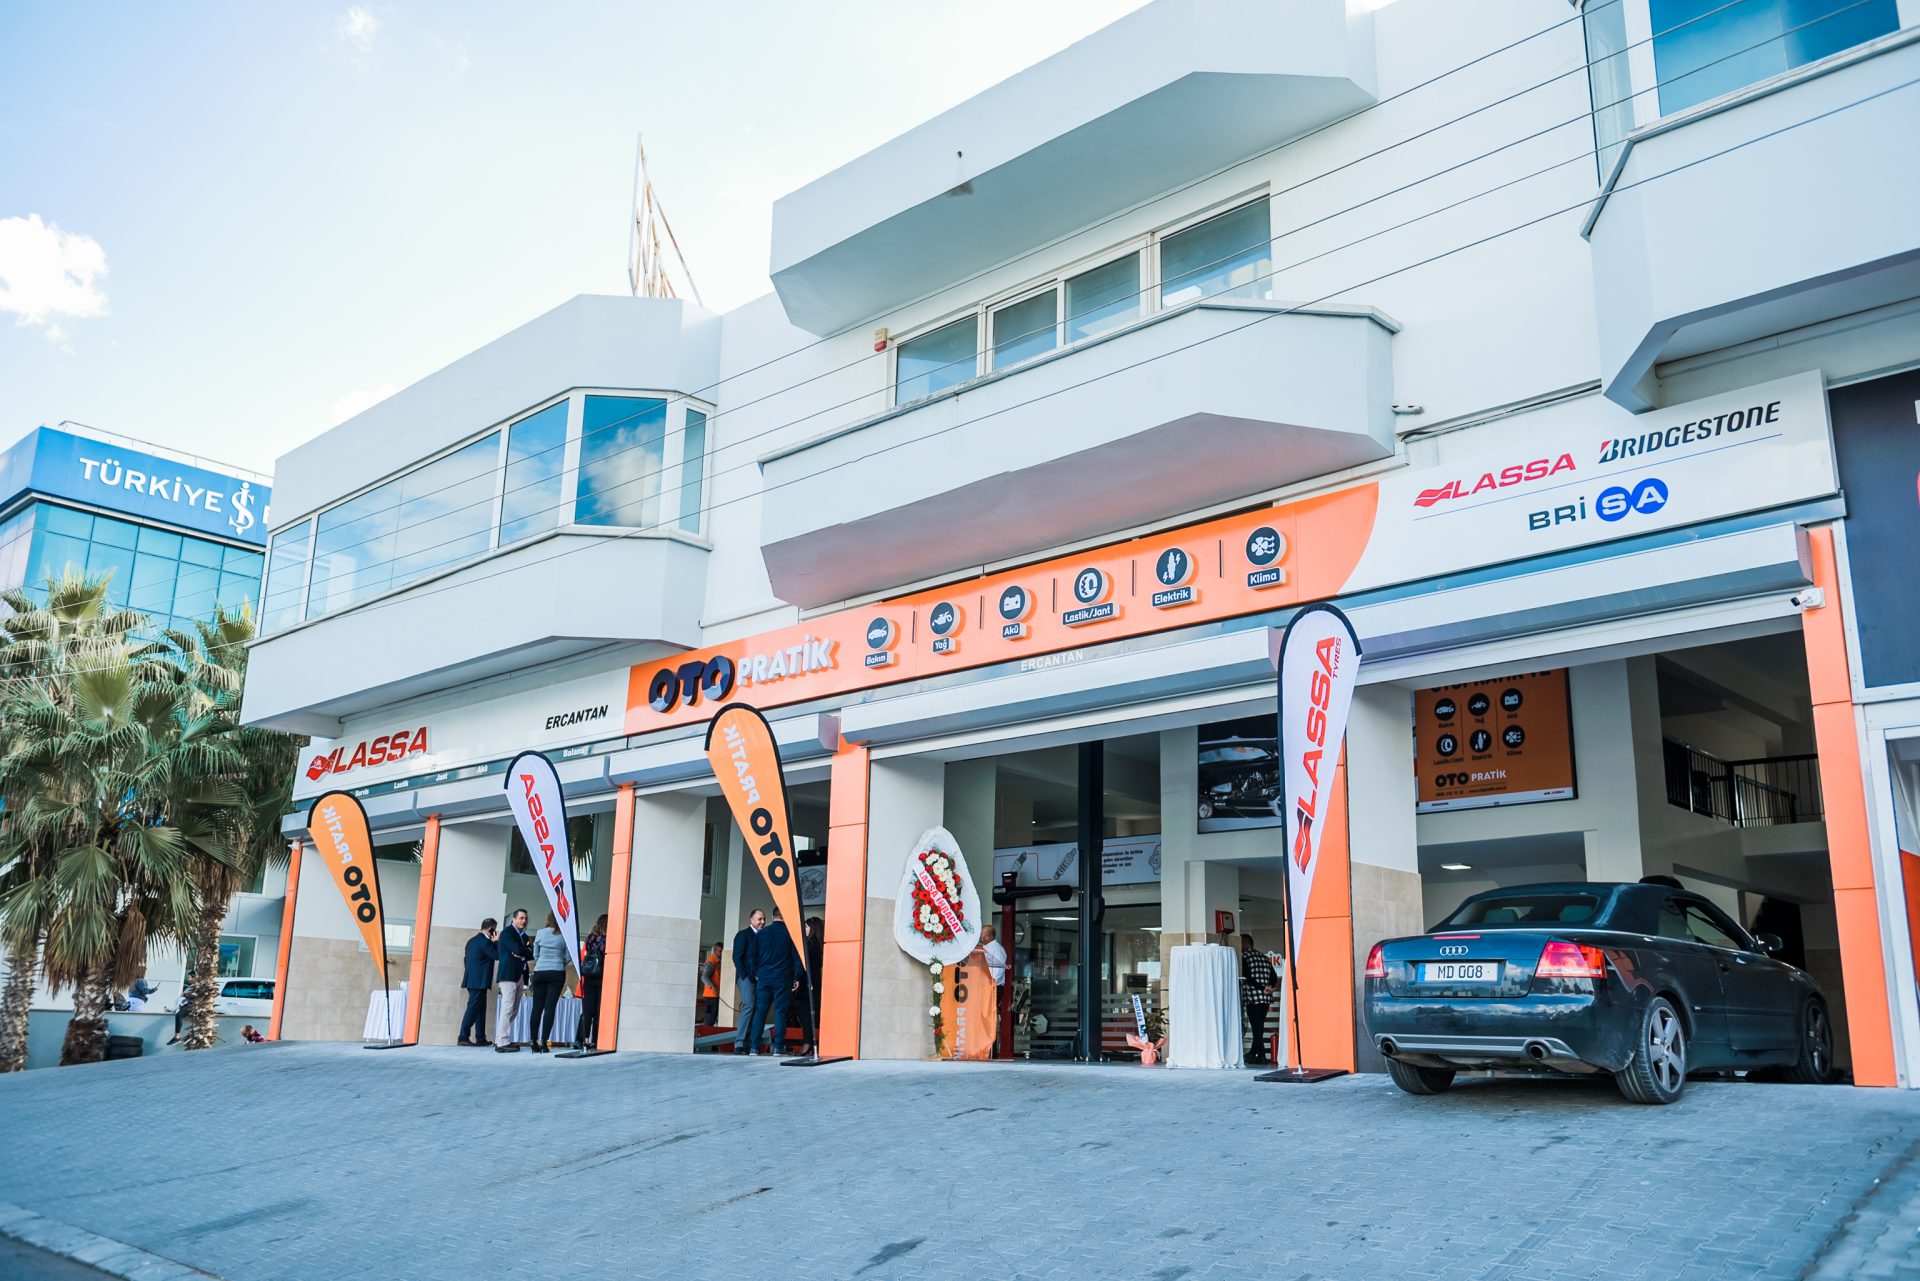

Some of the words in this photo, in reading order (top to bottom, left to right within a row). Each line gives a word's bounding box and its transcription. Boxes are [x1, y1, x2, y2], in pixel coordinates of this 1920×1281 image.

[1598, 401, 1780, 464] BRIDGESTONE
[79, 457, 224, 513] TÜRKİYE
[1453, 453, 1577, 499] LASSA
[1250, 572, 1278, 585] Klima
[1154, 590, 1189, 605] Elektrik
[1064, 605, 1112, 624] Lastik/Jant
[1003, 625, 1020, 637] Akü
[934, 638, 948, 651] Yağ
[866, 655, 886, 665] Bakım
[1021, 648, 1084, 672] ERCANTAN
[1332, 636, 1342, 680] TYRES
[648, 655, 736, 714] OTO
[736, 634, 836, 688] PRATİK
[545, 704, 609, 731] ERCANTAN
[1297, 636, 1336, 819] LASSA
[332, 726, 427, 774] LASSA
[1435, 771, 1470, 788] OTO
[1471, 768, 1507, 782] PRATİK
[918, 871, 939, 898] LASSA
[1437, 965, 1455, 979] MD
[1458, 965, 1483, 979] 008
